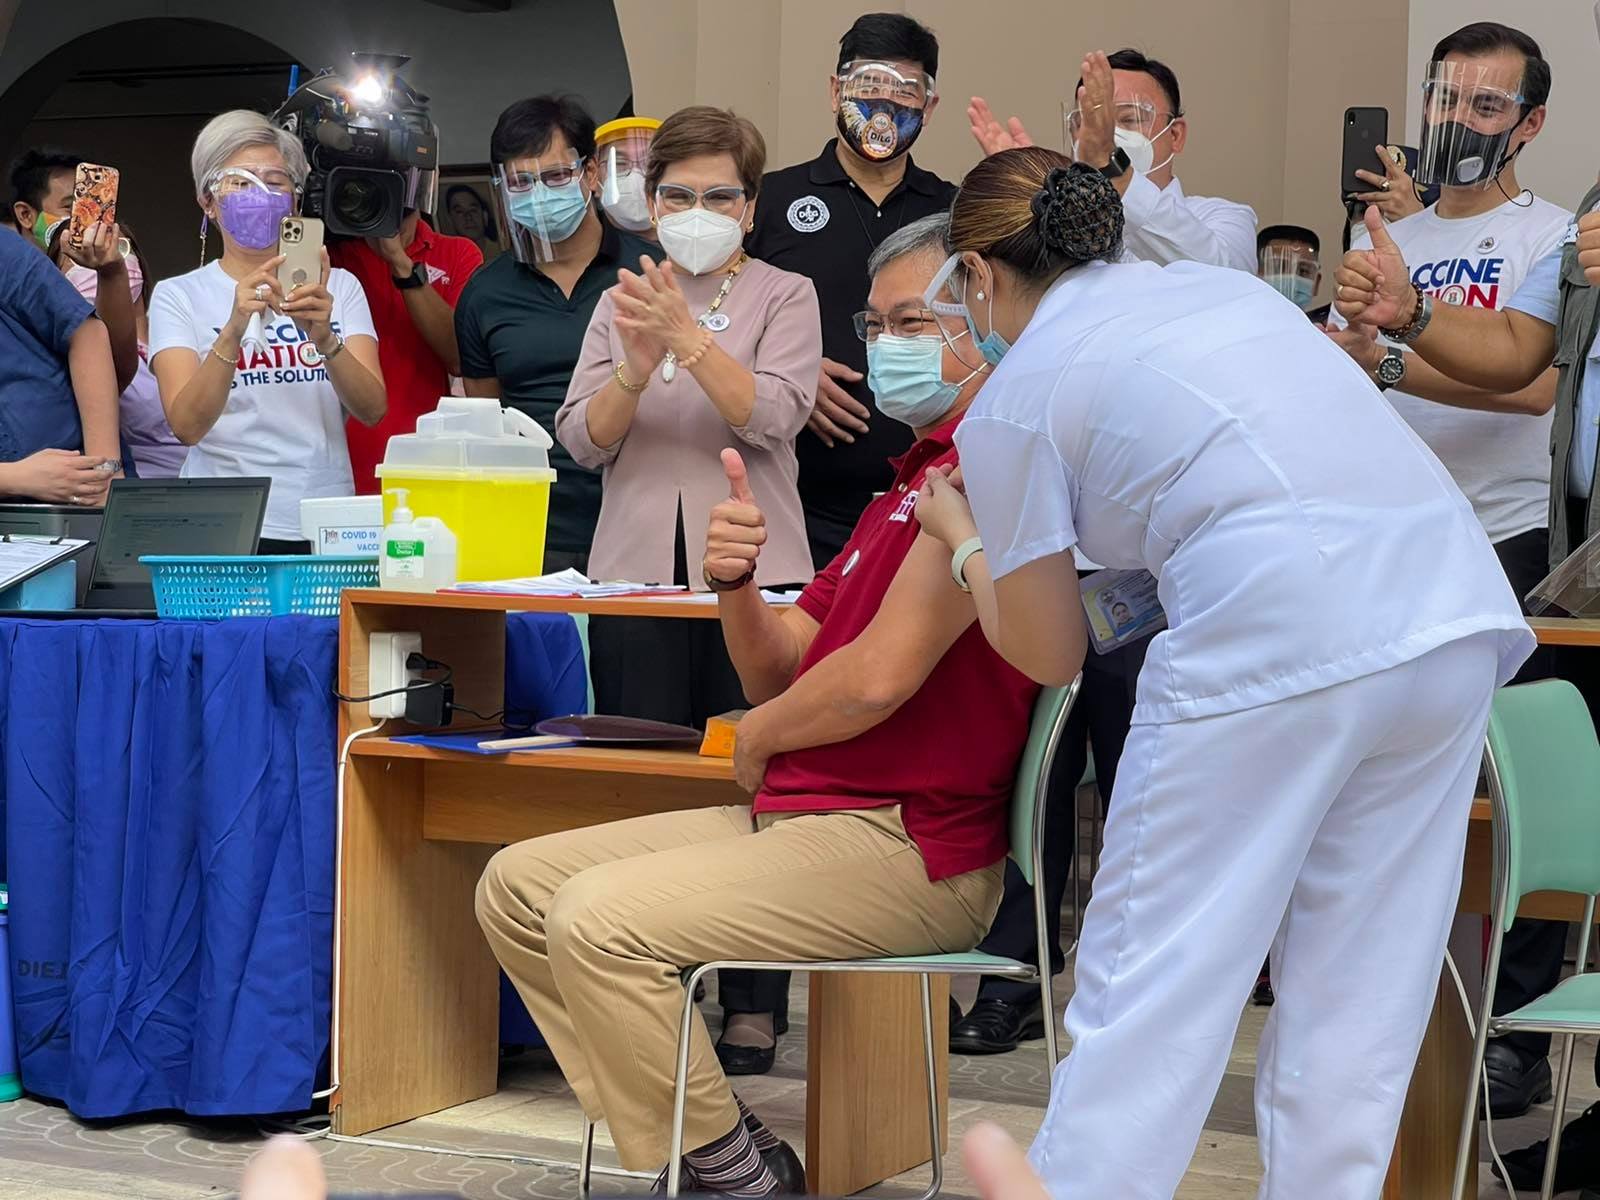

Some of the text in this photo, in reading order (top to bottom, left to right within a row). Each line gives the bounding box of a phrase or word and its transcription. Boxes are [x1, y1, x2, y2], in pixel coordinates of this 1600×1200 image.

[870, 132, 891, 143] DILG
[1406, 258, 1504, 290] CCINE
[241, 371, 269, 386] THE
[274, 368, 329, 384] SOLUTI
[341, 531, 367, 539] COVID
[369, 531, 377, 539] 19
[357, 543, 379, 551] VACCI
